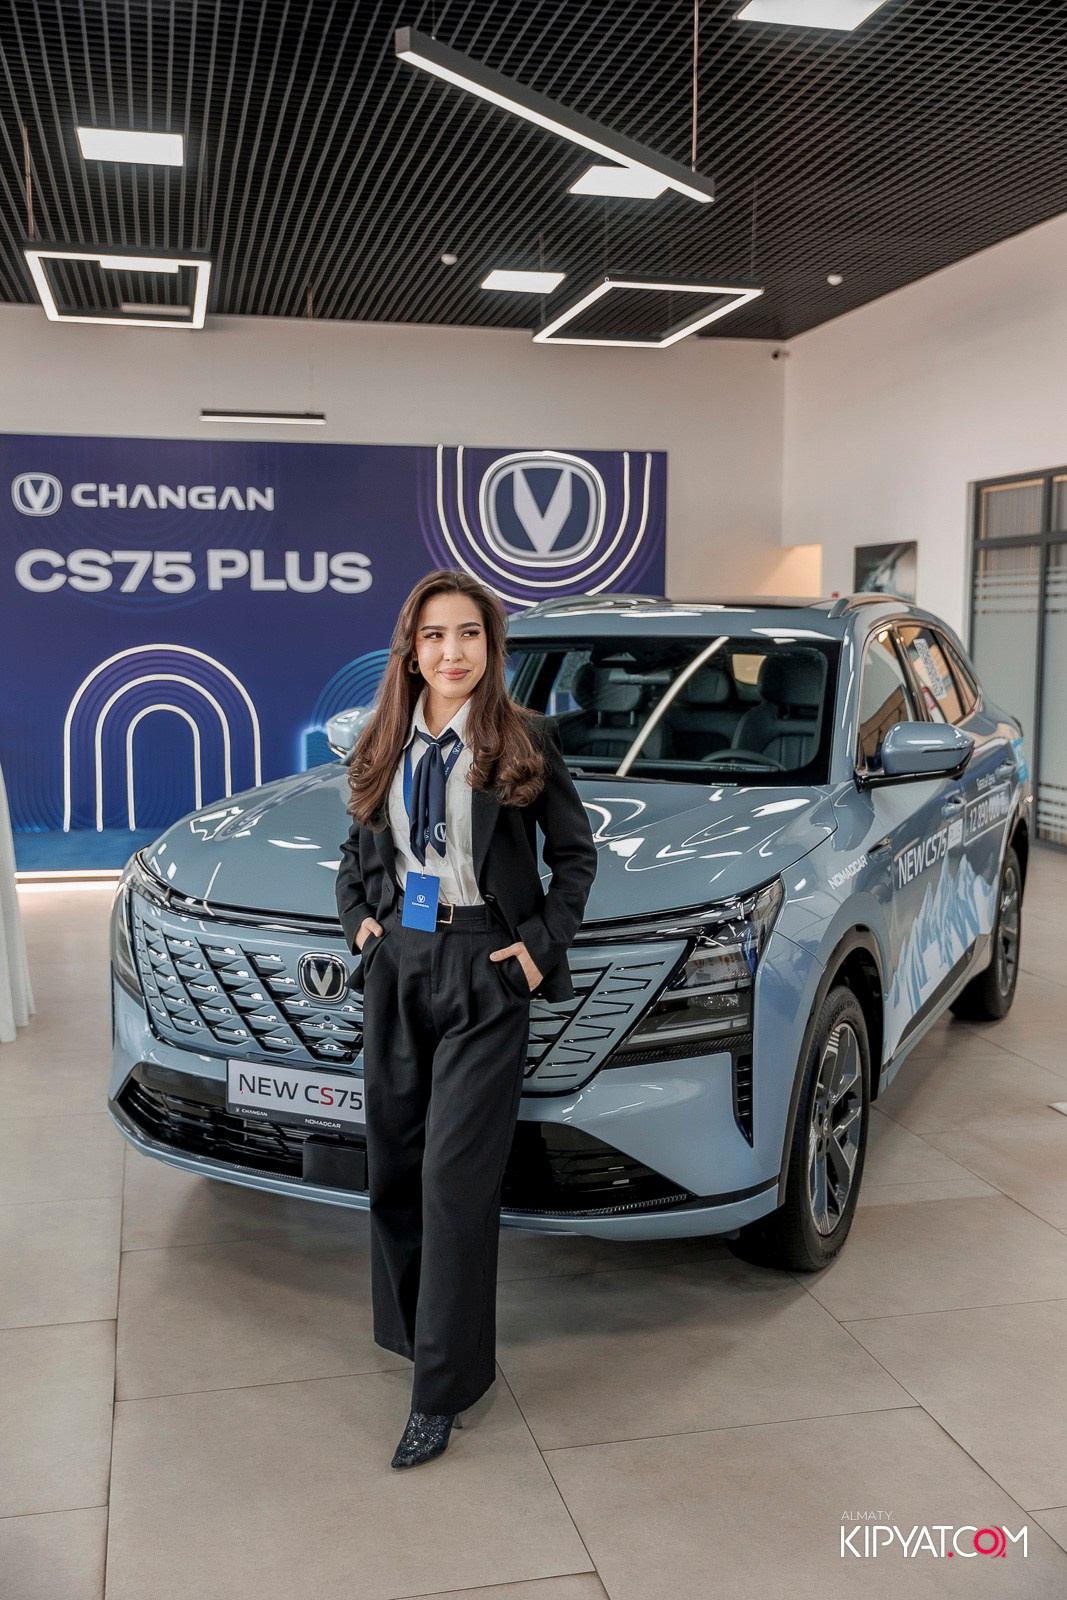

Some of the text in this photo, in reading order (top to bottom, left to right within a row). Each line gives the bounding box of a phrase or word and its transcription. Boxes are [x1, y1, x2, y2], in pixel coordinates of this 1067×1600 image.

[71, 482, 275, 512] CHANGAN
[15, 548, 373, 595] CS75 PLUS
[827, 854, 868, 890] NOMADCAR
[898, 841, 926, 889] NEW
[925, 829, 948, 868] CS75
[239, 1073, 363, 1111] NEW CS75
[241, 1108, 268, 1117] CHANGAN
[304, 1118, 342, 1129] NOMADCAR
